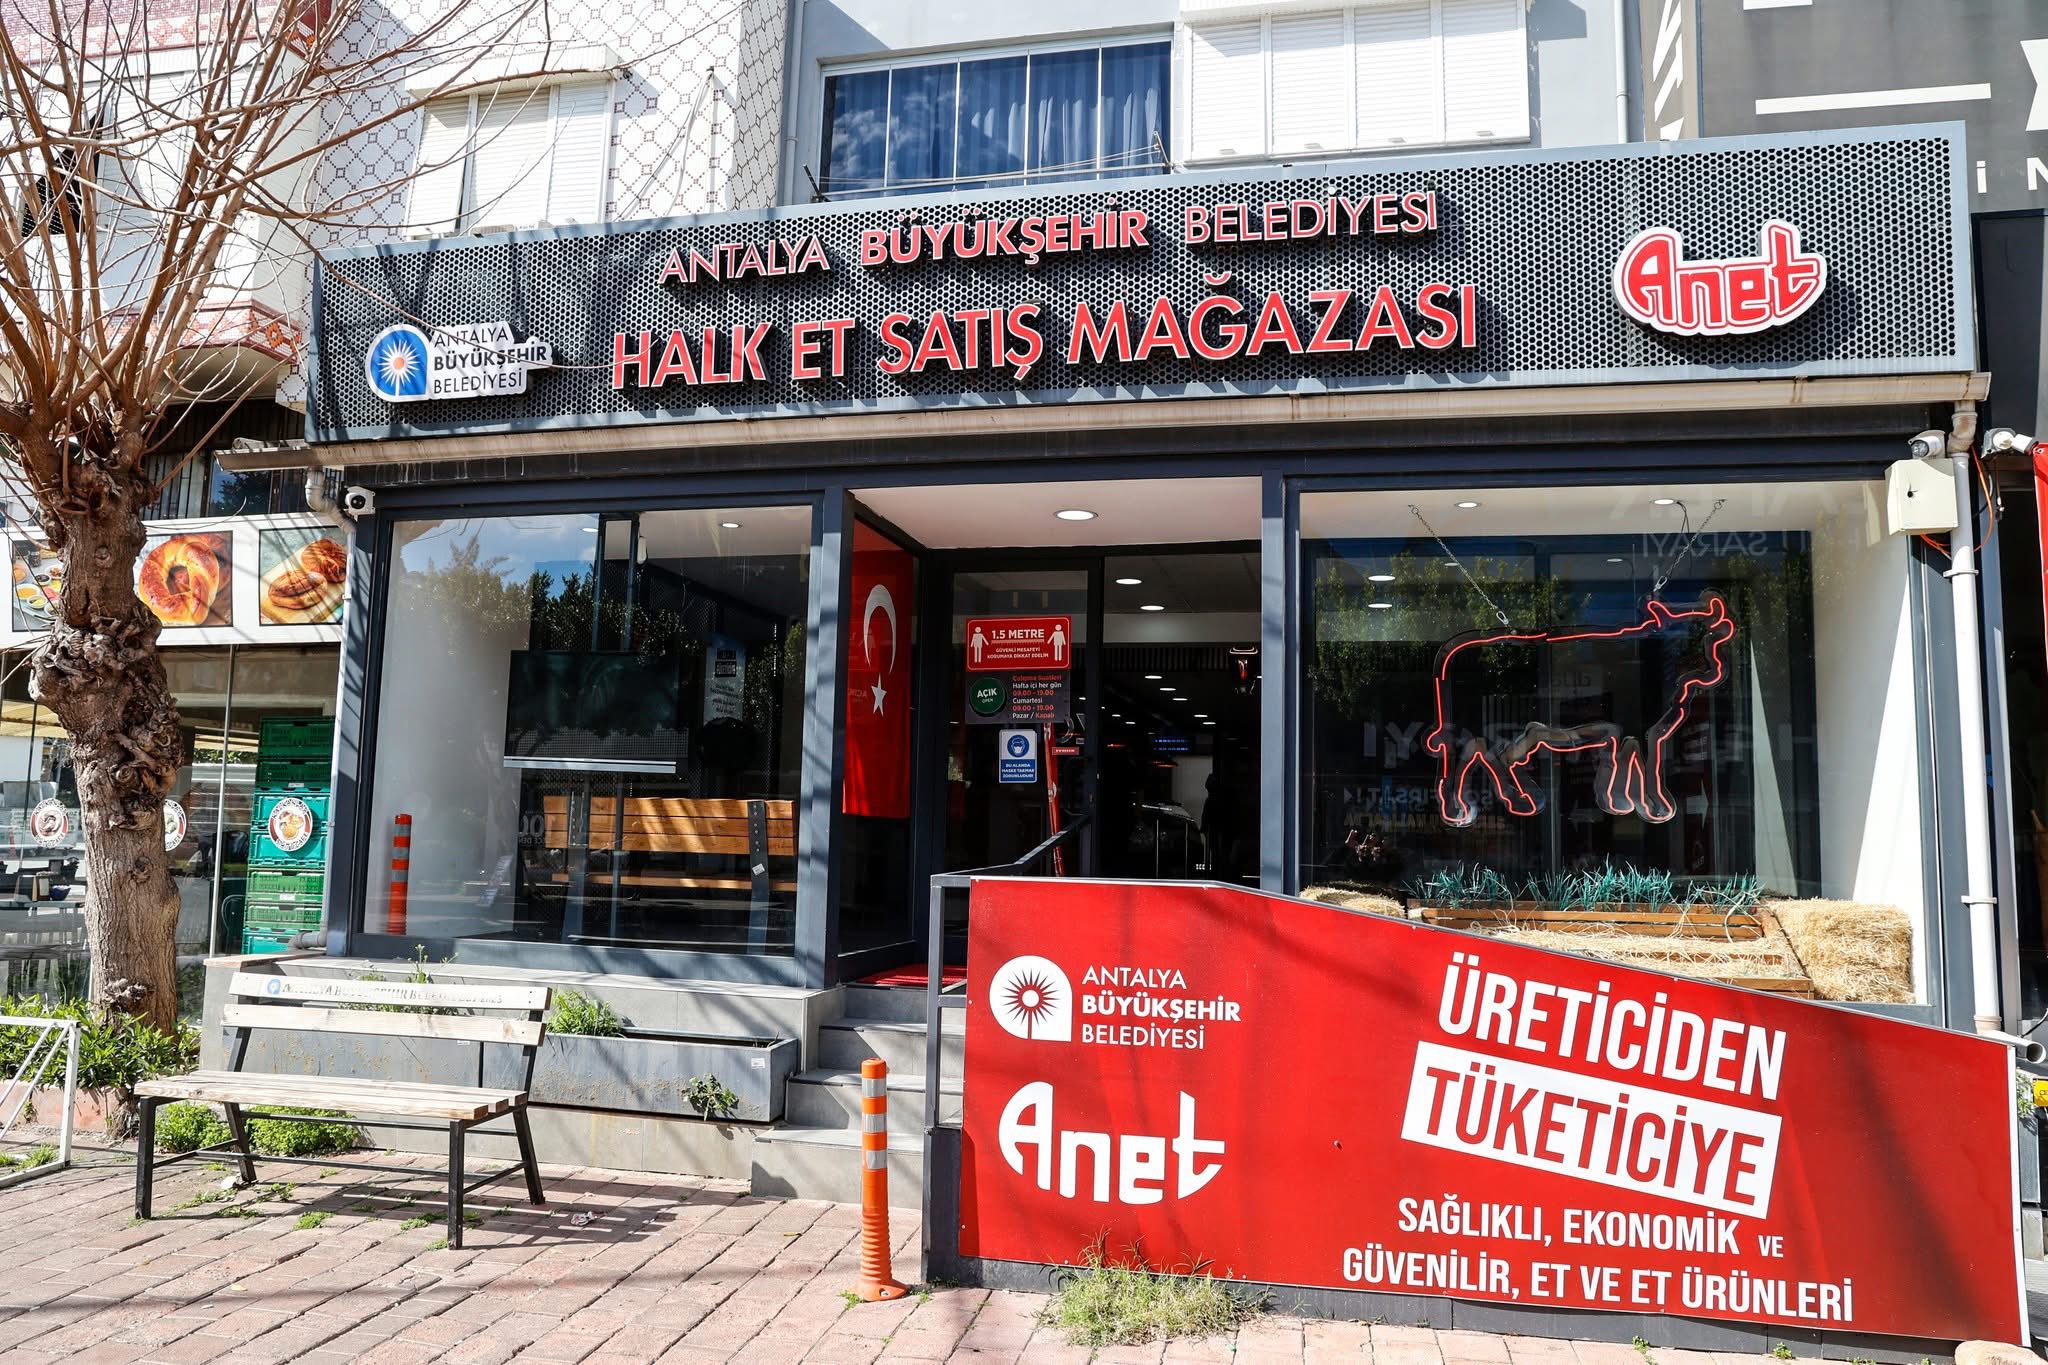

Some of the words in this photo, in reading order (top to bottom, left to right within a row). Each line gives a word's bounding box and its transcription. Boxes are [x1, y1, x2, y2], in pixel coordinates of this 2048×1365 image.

[658, 233, 831, 285] ANTALYA
[860, 197, 1149, 266] BÜYÜKŞEHİR
[1622, 223, 1820, 331] Anet
[433, 326, 509, 348] ANTALYA
[612, 321, 772, 390] HALK
[792, 319, 856, 380] ET
[877, 303, 1044, 380] SATIŞ
[1067, 271, 1477, 364] MAĞAZASI
[433, 341, 548, 371] BÜYÜKŞEHİR
[433, 368, 523, 395] BELEDİYESİ
[992, 629, 1006, 640] 1.5
[1008, 628, 1045, 639] METRE
[976, 688, 997, 698] AÇIK
[1049, 681, 1062, 689] gün
[1082, 964, 1187, 989] ANTALYA
[1082, 990, 1241, 1024] BÜYÜKŞEHİR
[1082, 1022, 1205, 1050] BELEDİYESİ
[1438, 951, 1787, 1101] ÜRETİCİDEN
[998, 1081, 1225, 1205] Anet
[1425, 1061, 1765, 1206] TÜKETİCİYE
[1398, 1193, 1553, 1249] SAĞLIKLI,
[1563, 1208, 1741, 1256] EKONOMİK
[1757, 1234, 1784, 1258] VE
[1343, 1243, 1519, 1300] GÜVENİLİR,
[1531, 1261, 1571, 1298] ET
[1579, 1266, 1621, 1303] VE
[1631, 1269, 1673, 1305] ET
[1681, 1266, 1854, 1322] ÜRÜNLERİ
